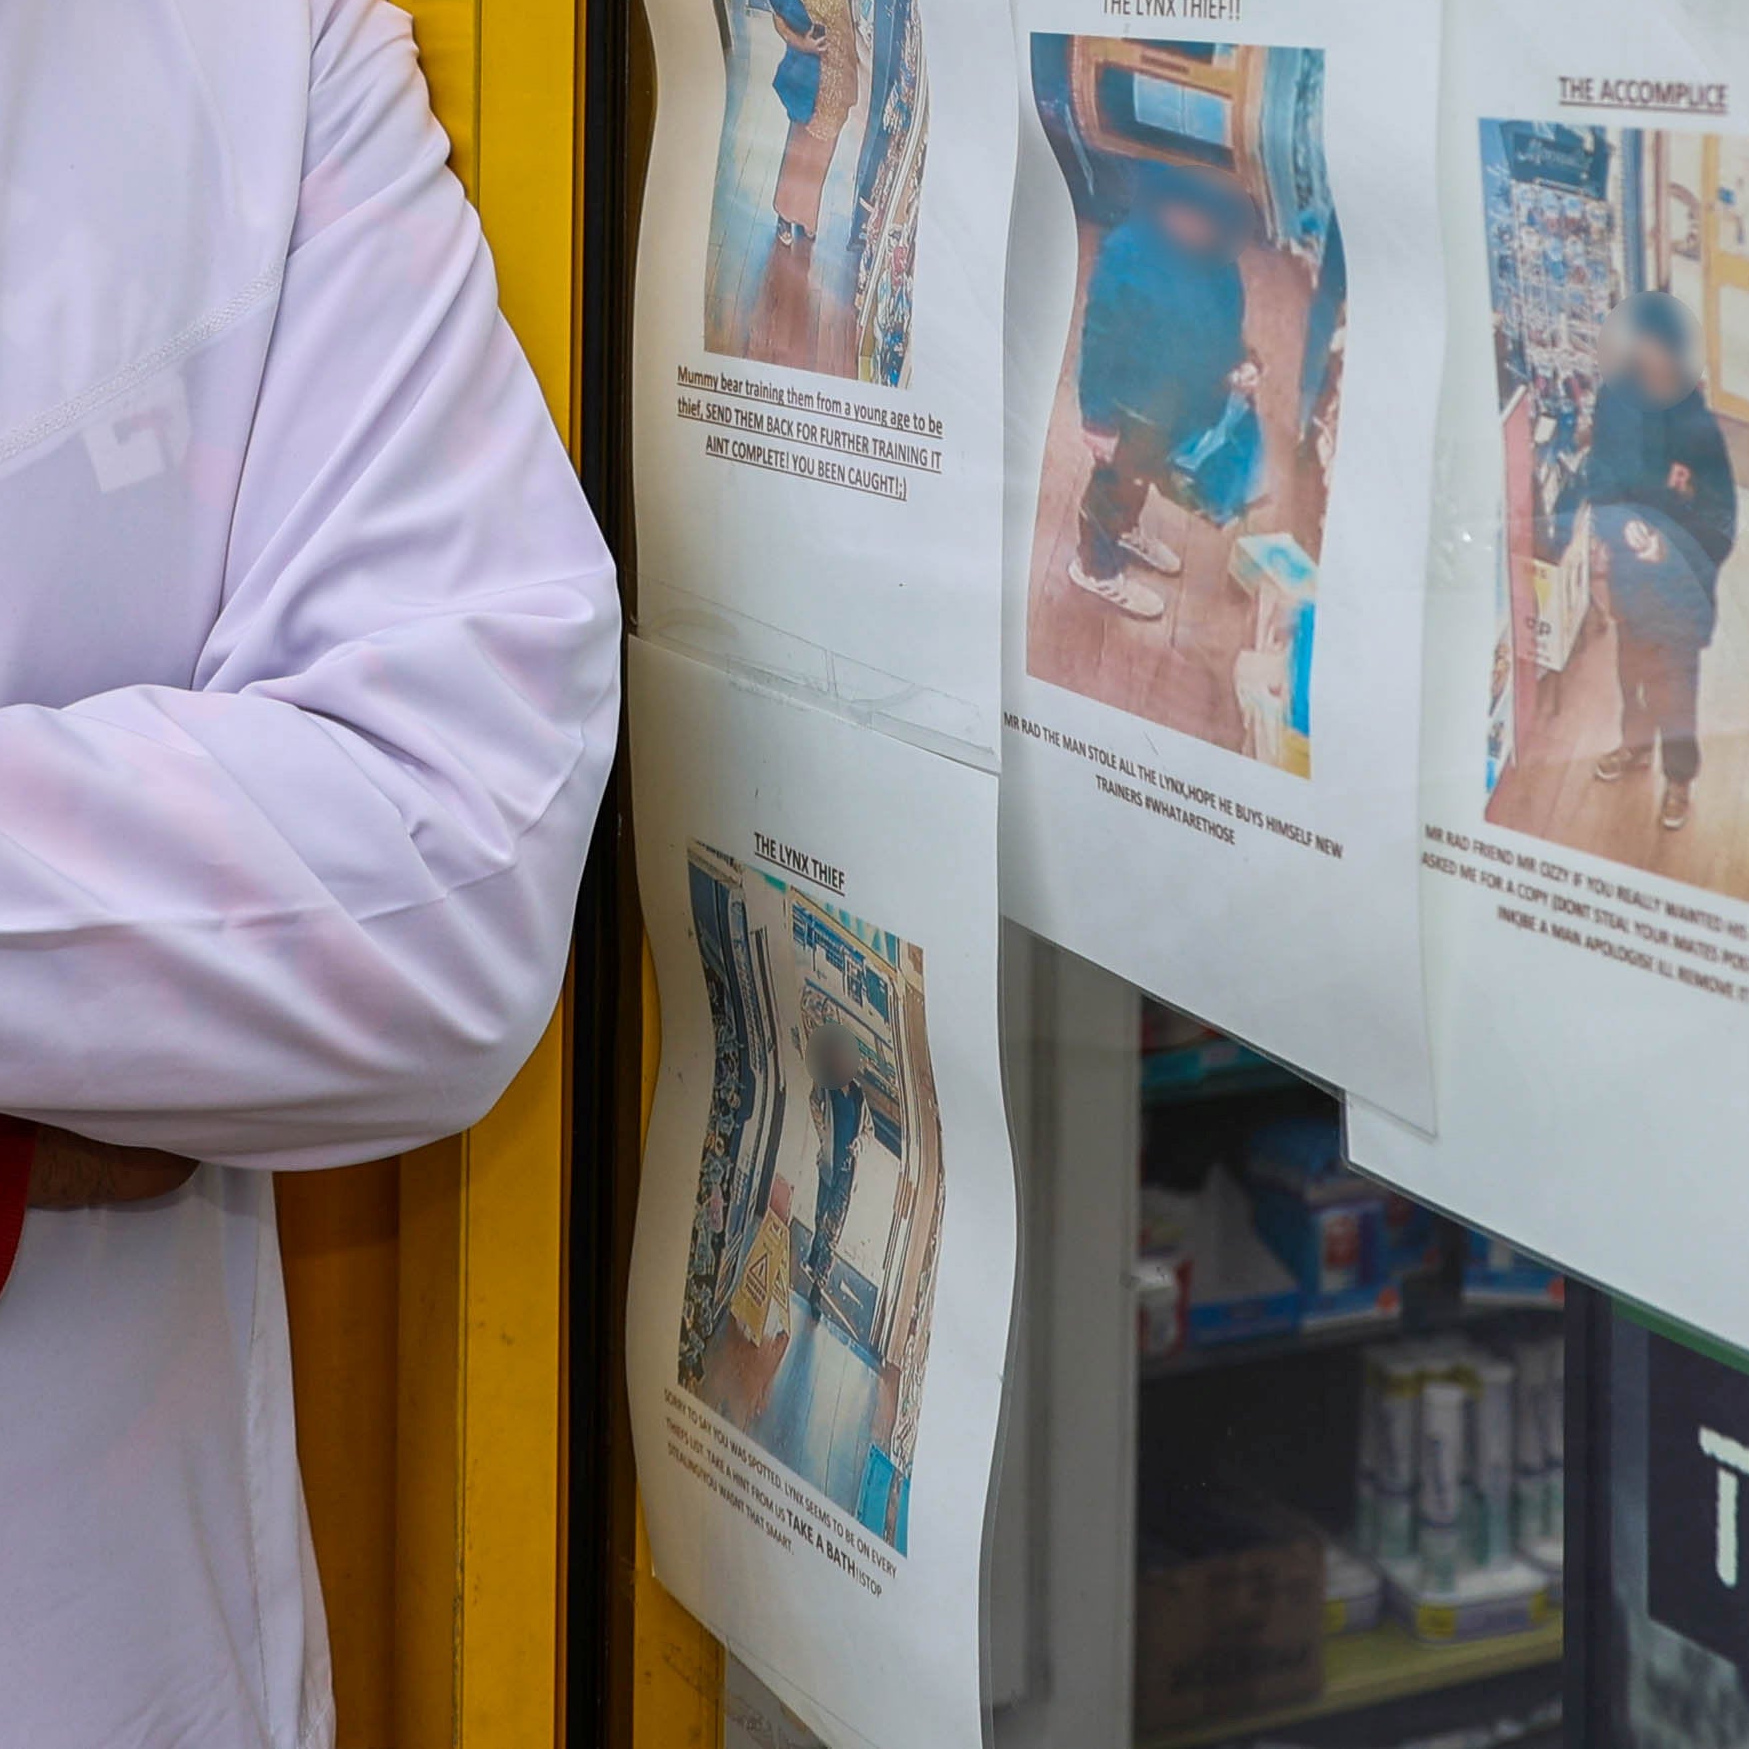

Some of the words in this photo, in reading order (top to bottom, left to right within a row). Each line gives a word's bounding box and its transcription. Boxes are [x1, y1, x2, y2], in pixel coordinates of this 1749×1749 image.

[1558, 76, 1594, 101] THE
[1600, 78, 1728, 108] ACCOMPLICE
[677, 364, 717, 391] Mummy
[721, 373, 741, 393] bear
[745, 378, 783, 405] training
[787, 386, 813, 408] them
[817, 392, 841, 414] from
[845, 401, 850, 415] a
[854, 403, 887, 426] young
[890, 411, 909, 431] age
[913, 412, 925, 431] to
[928, 415, 942, 435] be
[677, 396, 702, 419] thief,
[706, 402, 731, 423] SEND
[735, 408, 763, 430] THEM
[767, 415, 792, 437] BACK
[796, 421, 817, 442] FOR
[820, 426, 868, 453] FURTHER
[873, 438, 927, 466] TRAINING
[931, 450, 941, 469] IT
[706, 434, 727, 455] AINT
[731, 440, 788, 469] COMPLETE!
[793, 454, 814, 475] YOU
[817, 459, 845, 482] BEEN
[1003, 711, 1019, 730] MR
[1021, 718, 1040, 739] RAD
[1043, 727, 1059, 746] THE
[1062, 734, 1085, 757] MAN
[1088, 744, 1115, 769] STOLE
[1119, 756, 1134, 776] ALL
[1139, 764, 1155, 785] THE
[1219, 796, 1231, 815] HE
[1235, 802, 1263, 828] BUYS
[1266, 814, 1311, 847] HIMSELF
[1315, 834, 1343, 860] NEW
[1095, 774, 1141, 806] TRAINERS
[754, 832, 776, 859] THE
[779, 843, 810, 875] LYNX
[812, 859, 846, 890] THIEF
[713, 1426, 727, 1447] YOU
[730, 1440, 746, 1462] WAS
[748, 1453, 781, 1489] SPOTTED.
[785, 1482, 803, 1506] LYNX
[805, 1498, 830, 1527] SEEMS
[833, 1519, 843, 1537] TO
[845, 1528, 853, 1546] BE
[857, 1537, 869, 1558] ON
[871, 1549, 896, 1579] EVERY
[746, 1506, 763, 1528] THAT
[751, 1483, 773, 1511] FROM
[775, 1502, 785, 1522] US
[787, 1511, 812, 1543] TAKE
[816, 1533, 823, 1551] A
